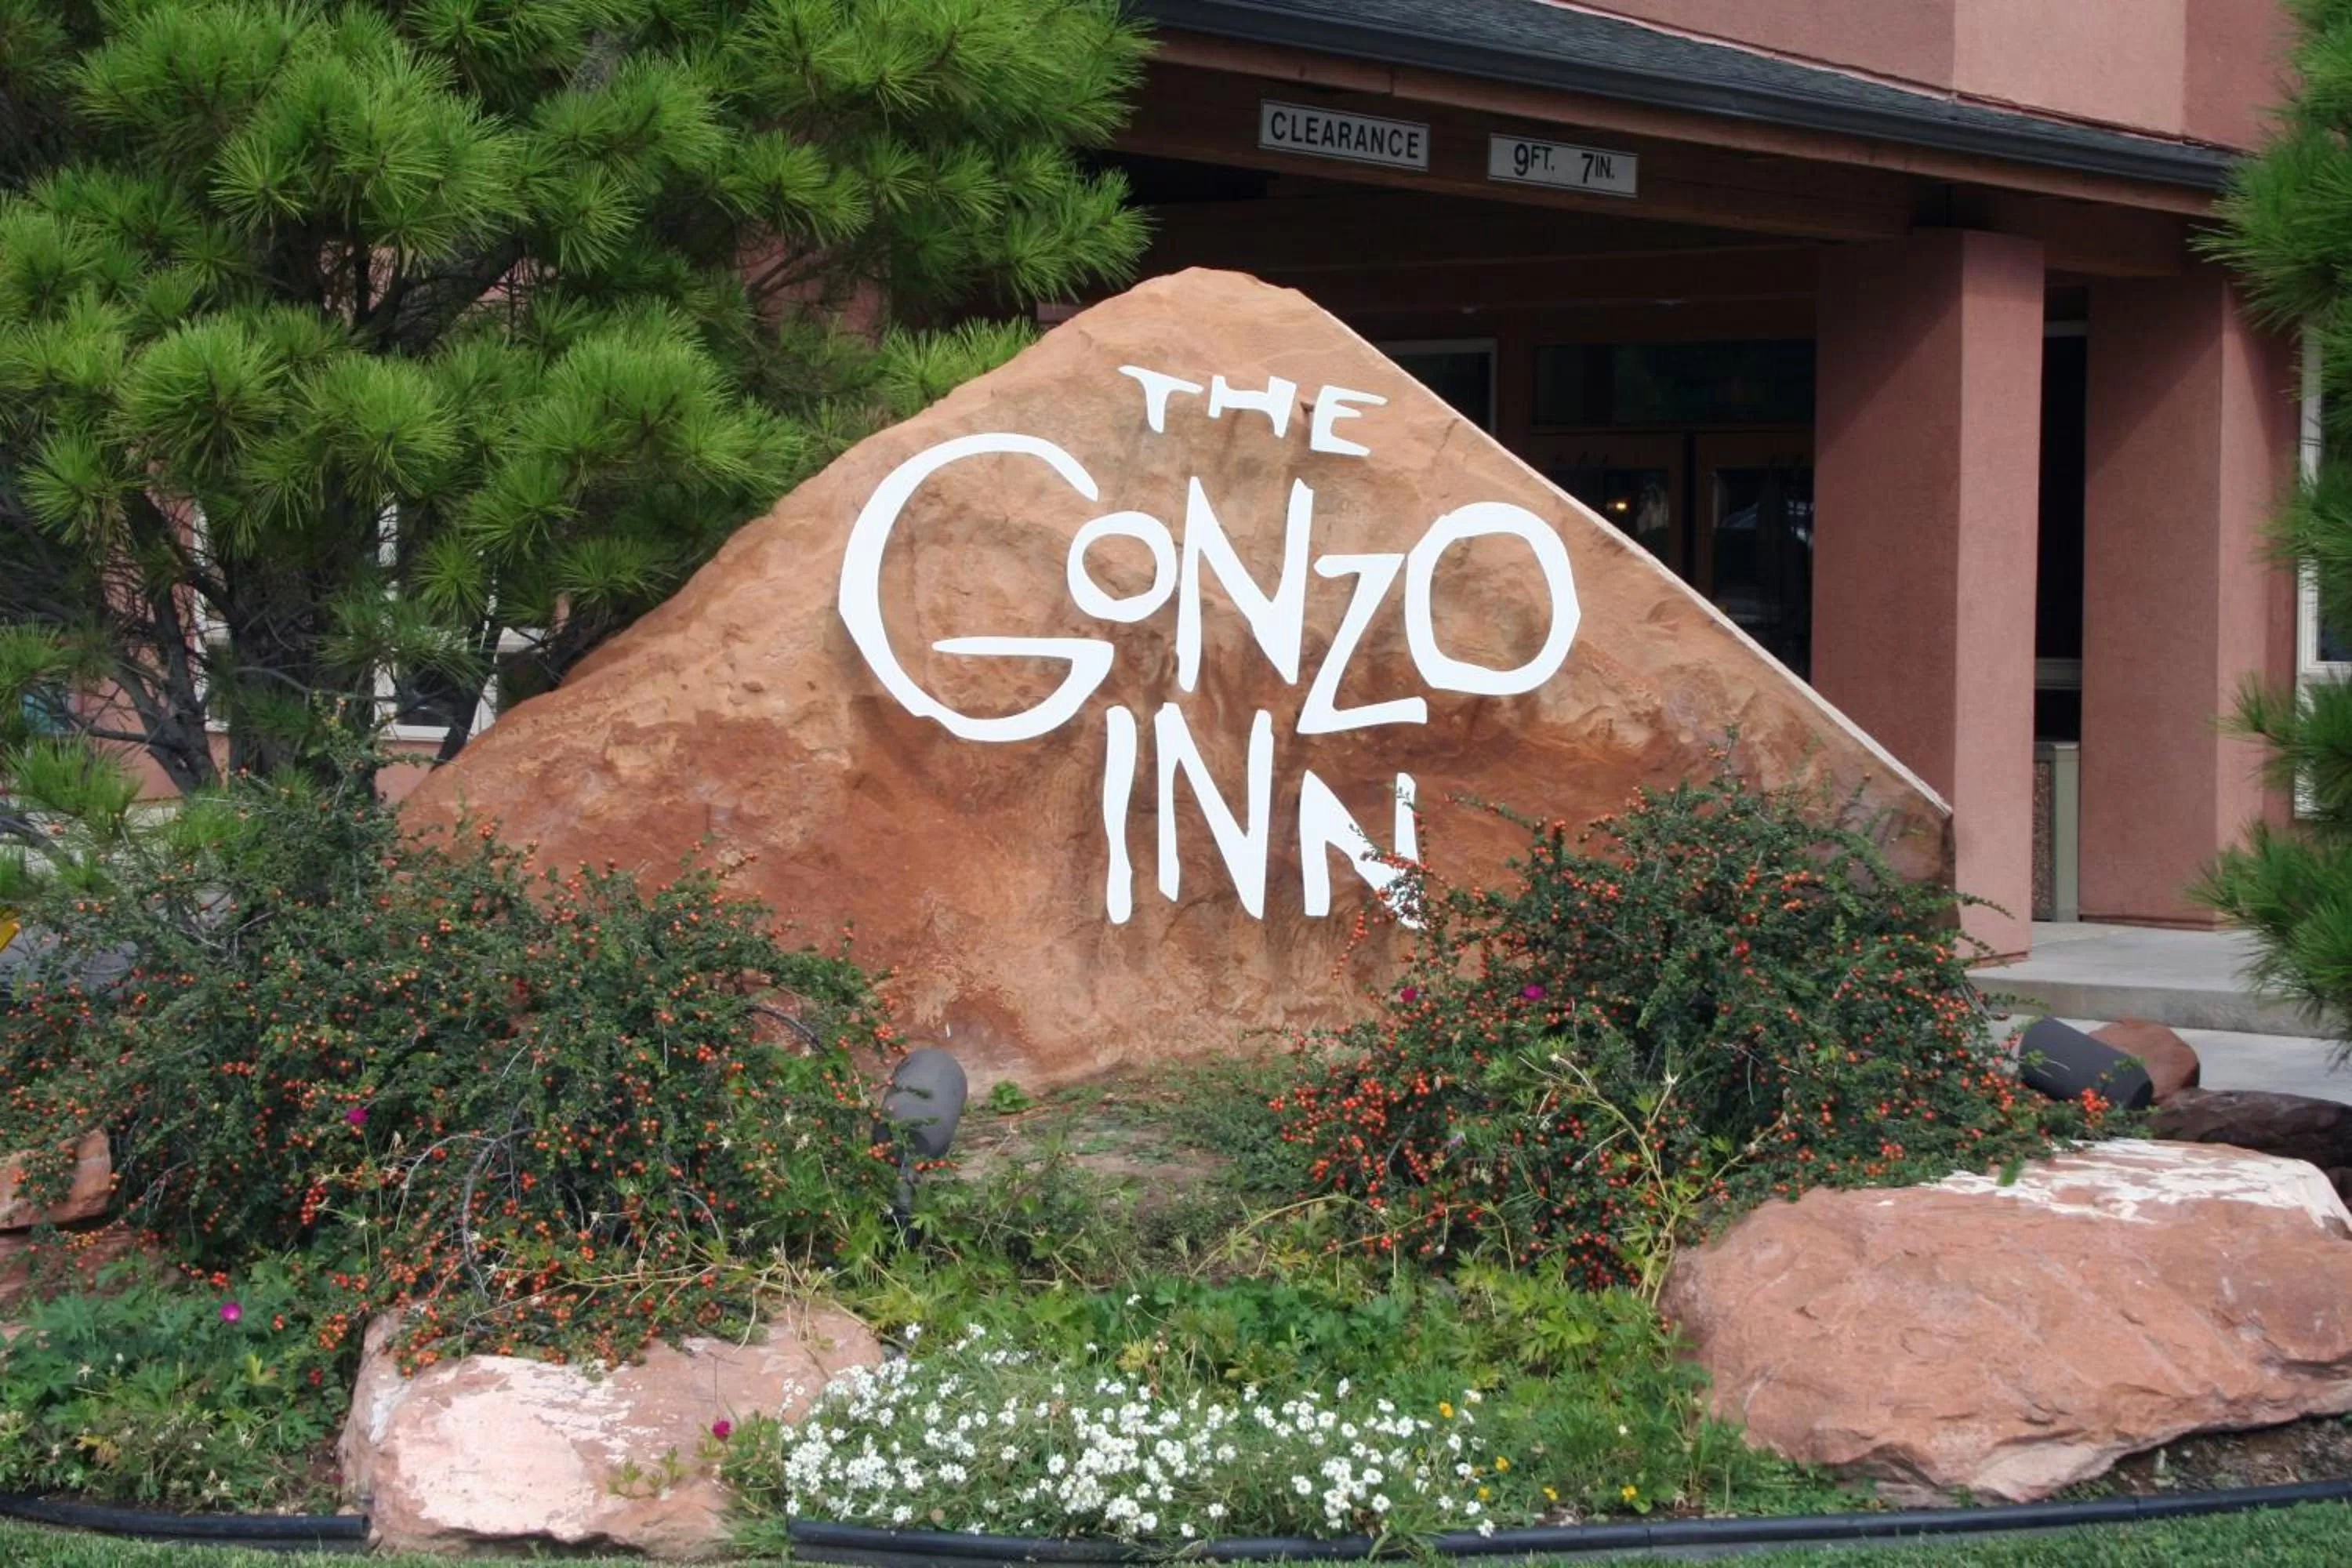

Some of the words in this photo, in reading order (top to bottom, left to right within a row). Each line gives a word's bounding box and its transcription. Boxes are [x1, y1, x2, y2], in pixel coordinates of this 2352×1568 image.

[1270, 111, 1420, 159] CLEARANCE
[1117, 365, 1387, 457] THE
[838, 432, 1581, 742] GONZO
[1102, 702, 1425, 929] INN
